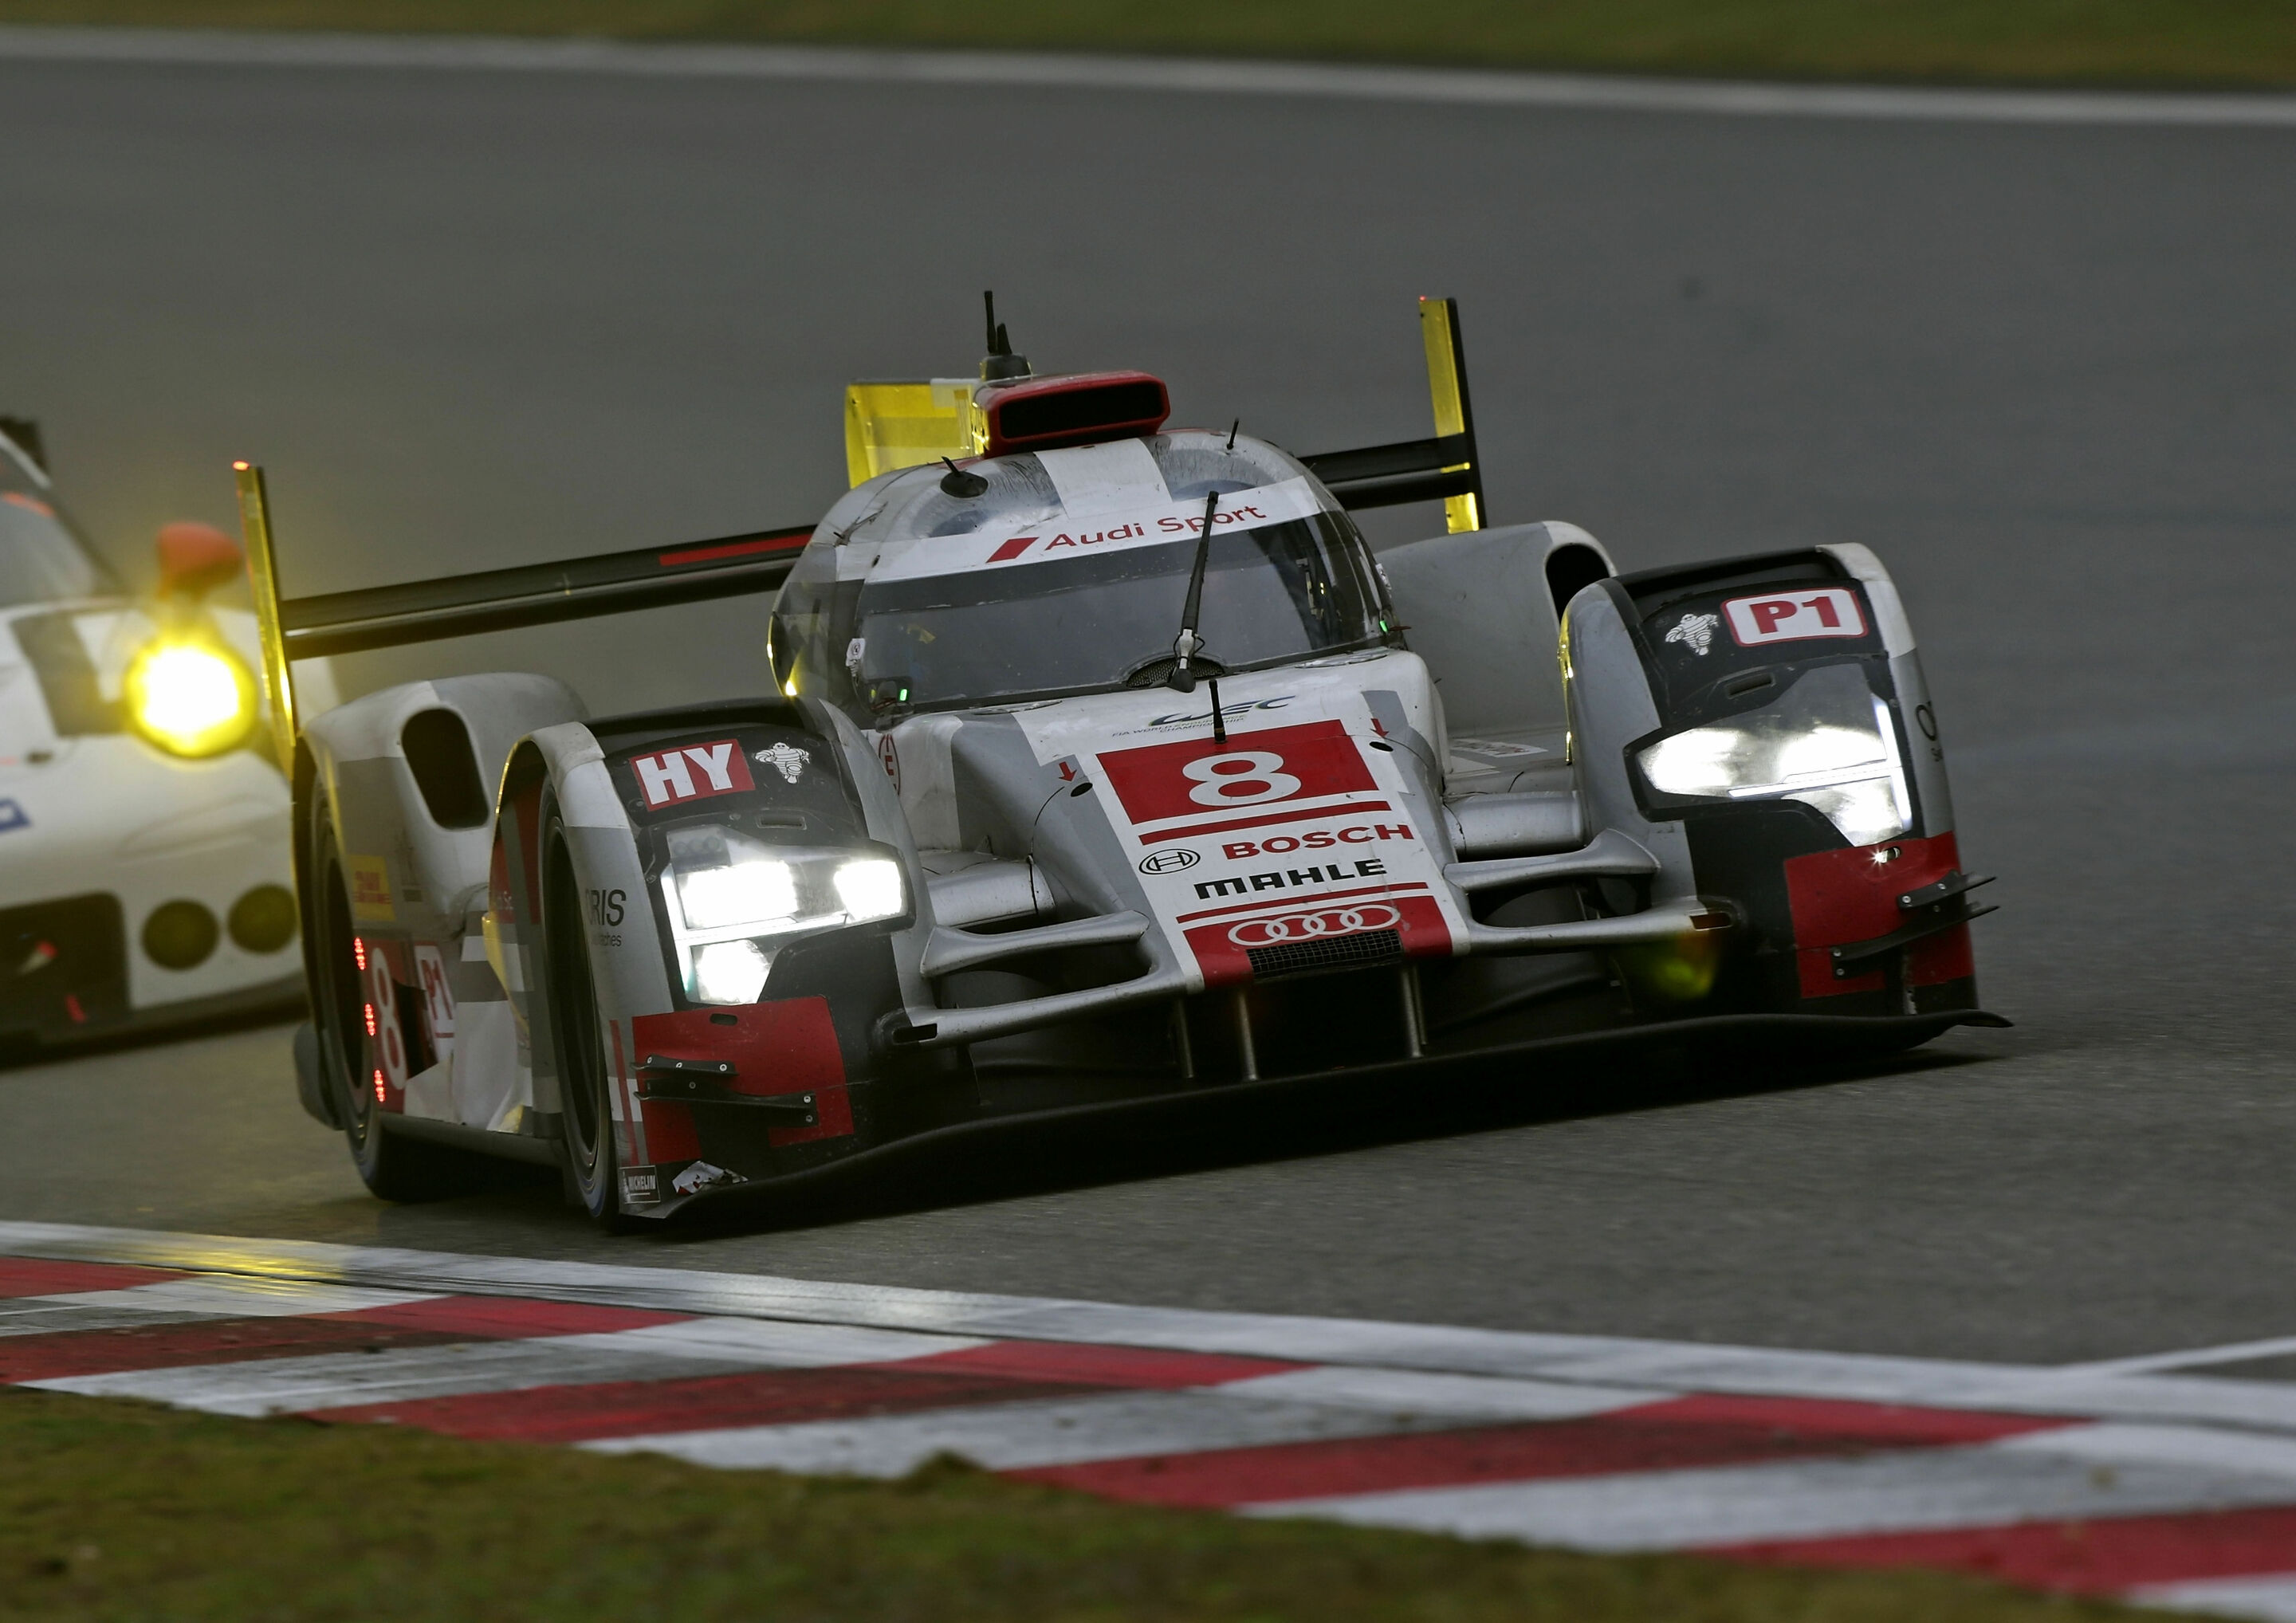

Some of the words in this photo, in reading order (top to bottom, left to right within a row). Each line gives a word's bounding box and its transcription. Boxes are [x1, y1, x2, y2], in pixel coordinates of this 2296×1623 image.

[1044, 523, 1145, 551] Audi
[1158, 505, 1267, 532] Sport
[1749, 596, 1841, 635] P1
[635, 743, 733, 805] HY
[1182, 751, 1302, 807] 8
[1221, 824, 1415, 860] BOSCH
[1193, 858, 1388, 900] MAHLE
[418, 959, 454, 1020] P1
[372, 947, 408, 1091] 8
